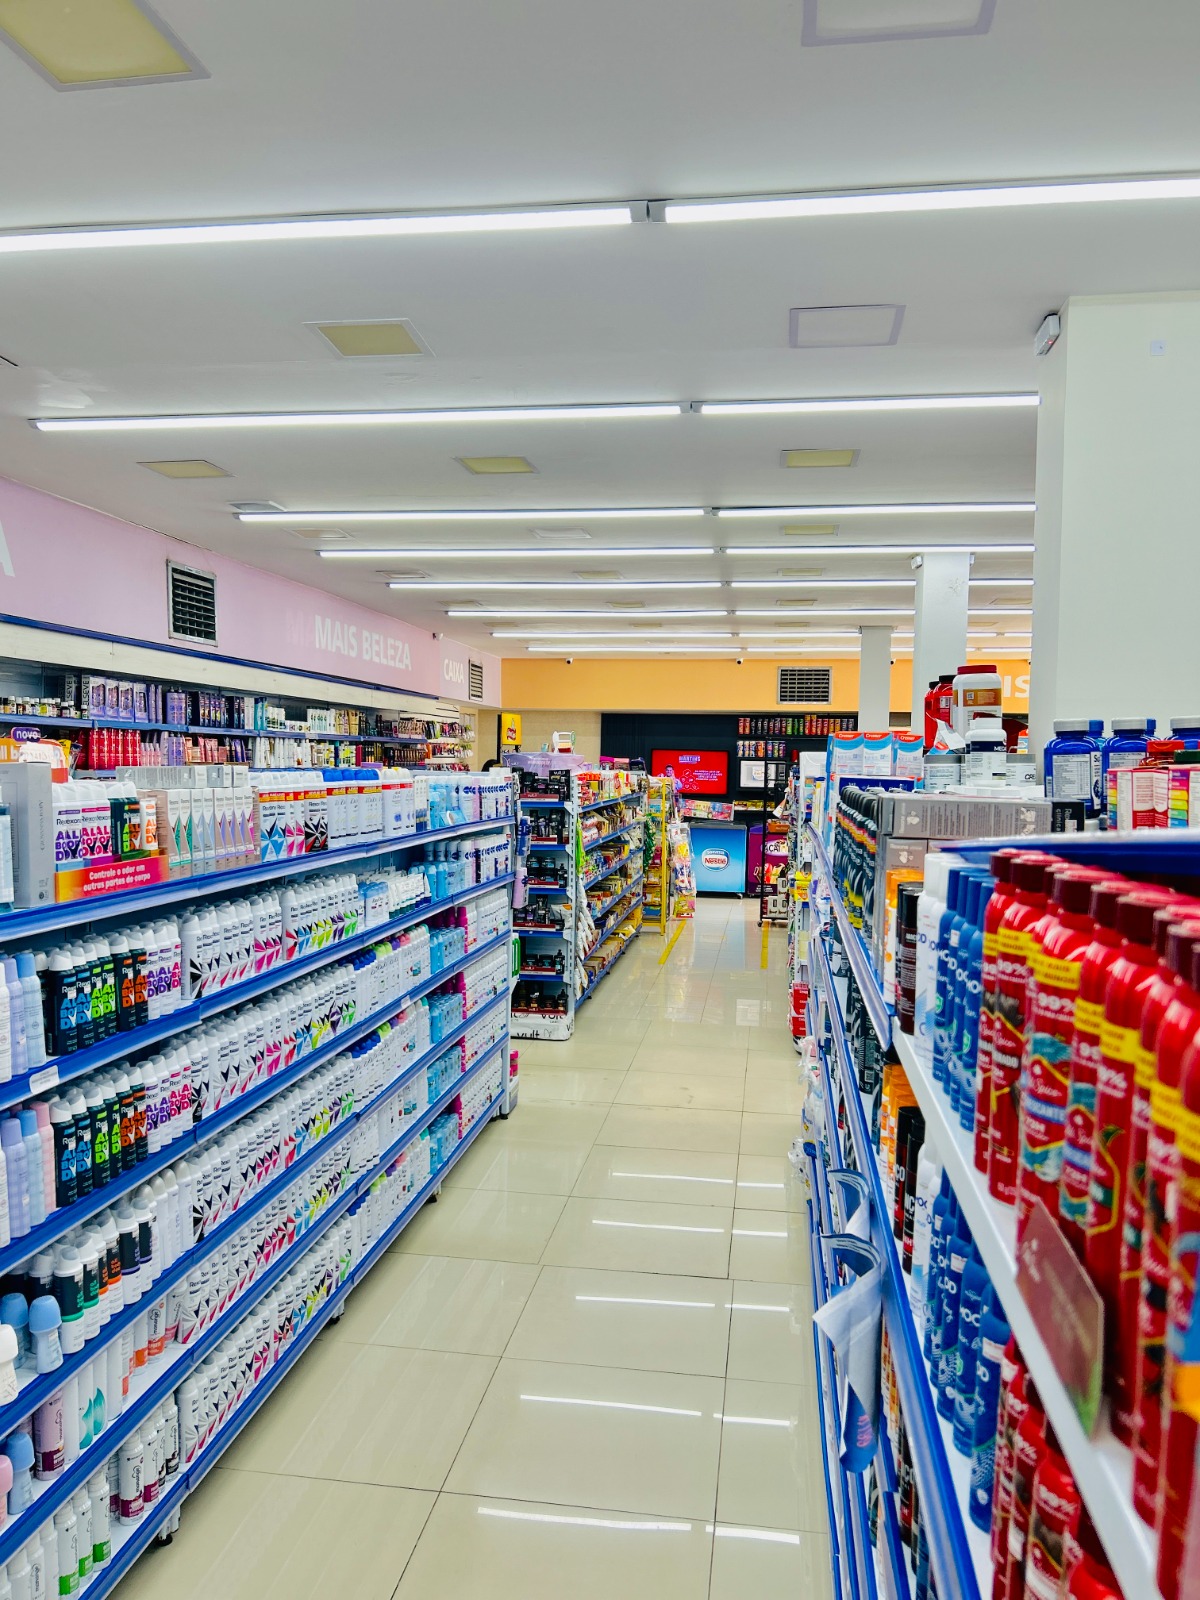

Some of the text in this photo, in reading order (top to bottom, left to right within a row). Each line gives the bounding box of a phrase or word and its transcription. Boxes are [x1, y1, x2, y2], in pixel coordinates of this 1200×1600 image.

[314, 614, 412, 672] MAIS BELEZA
[443, 658, 465, 684] CAIXA
[16, 729, 38, 739] novo
[1055, 808, 1063, 832] clinica
[704, 856, 727, 866] Nestlé
[83, 881, 105, 892] outras
[106, 878, 125, 890] partes
[134, 872, 151, 883] corpo
[89, 868, 116, 881] Controle
[122, 865, 135, 874] odor
[136, 864, 145, 872] em
